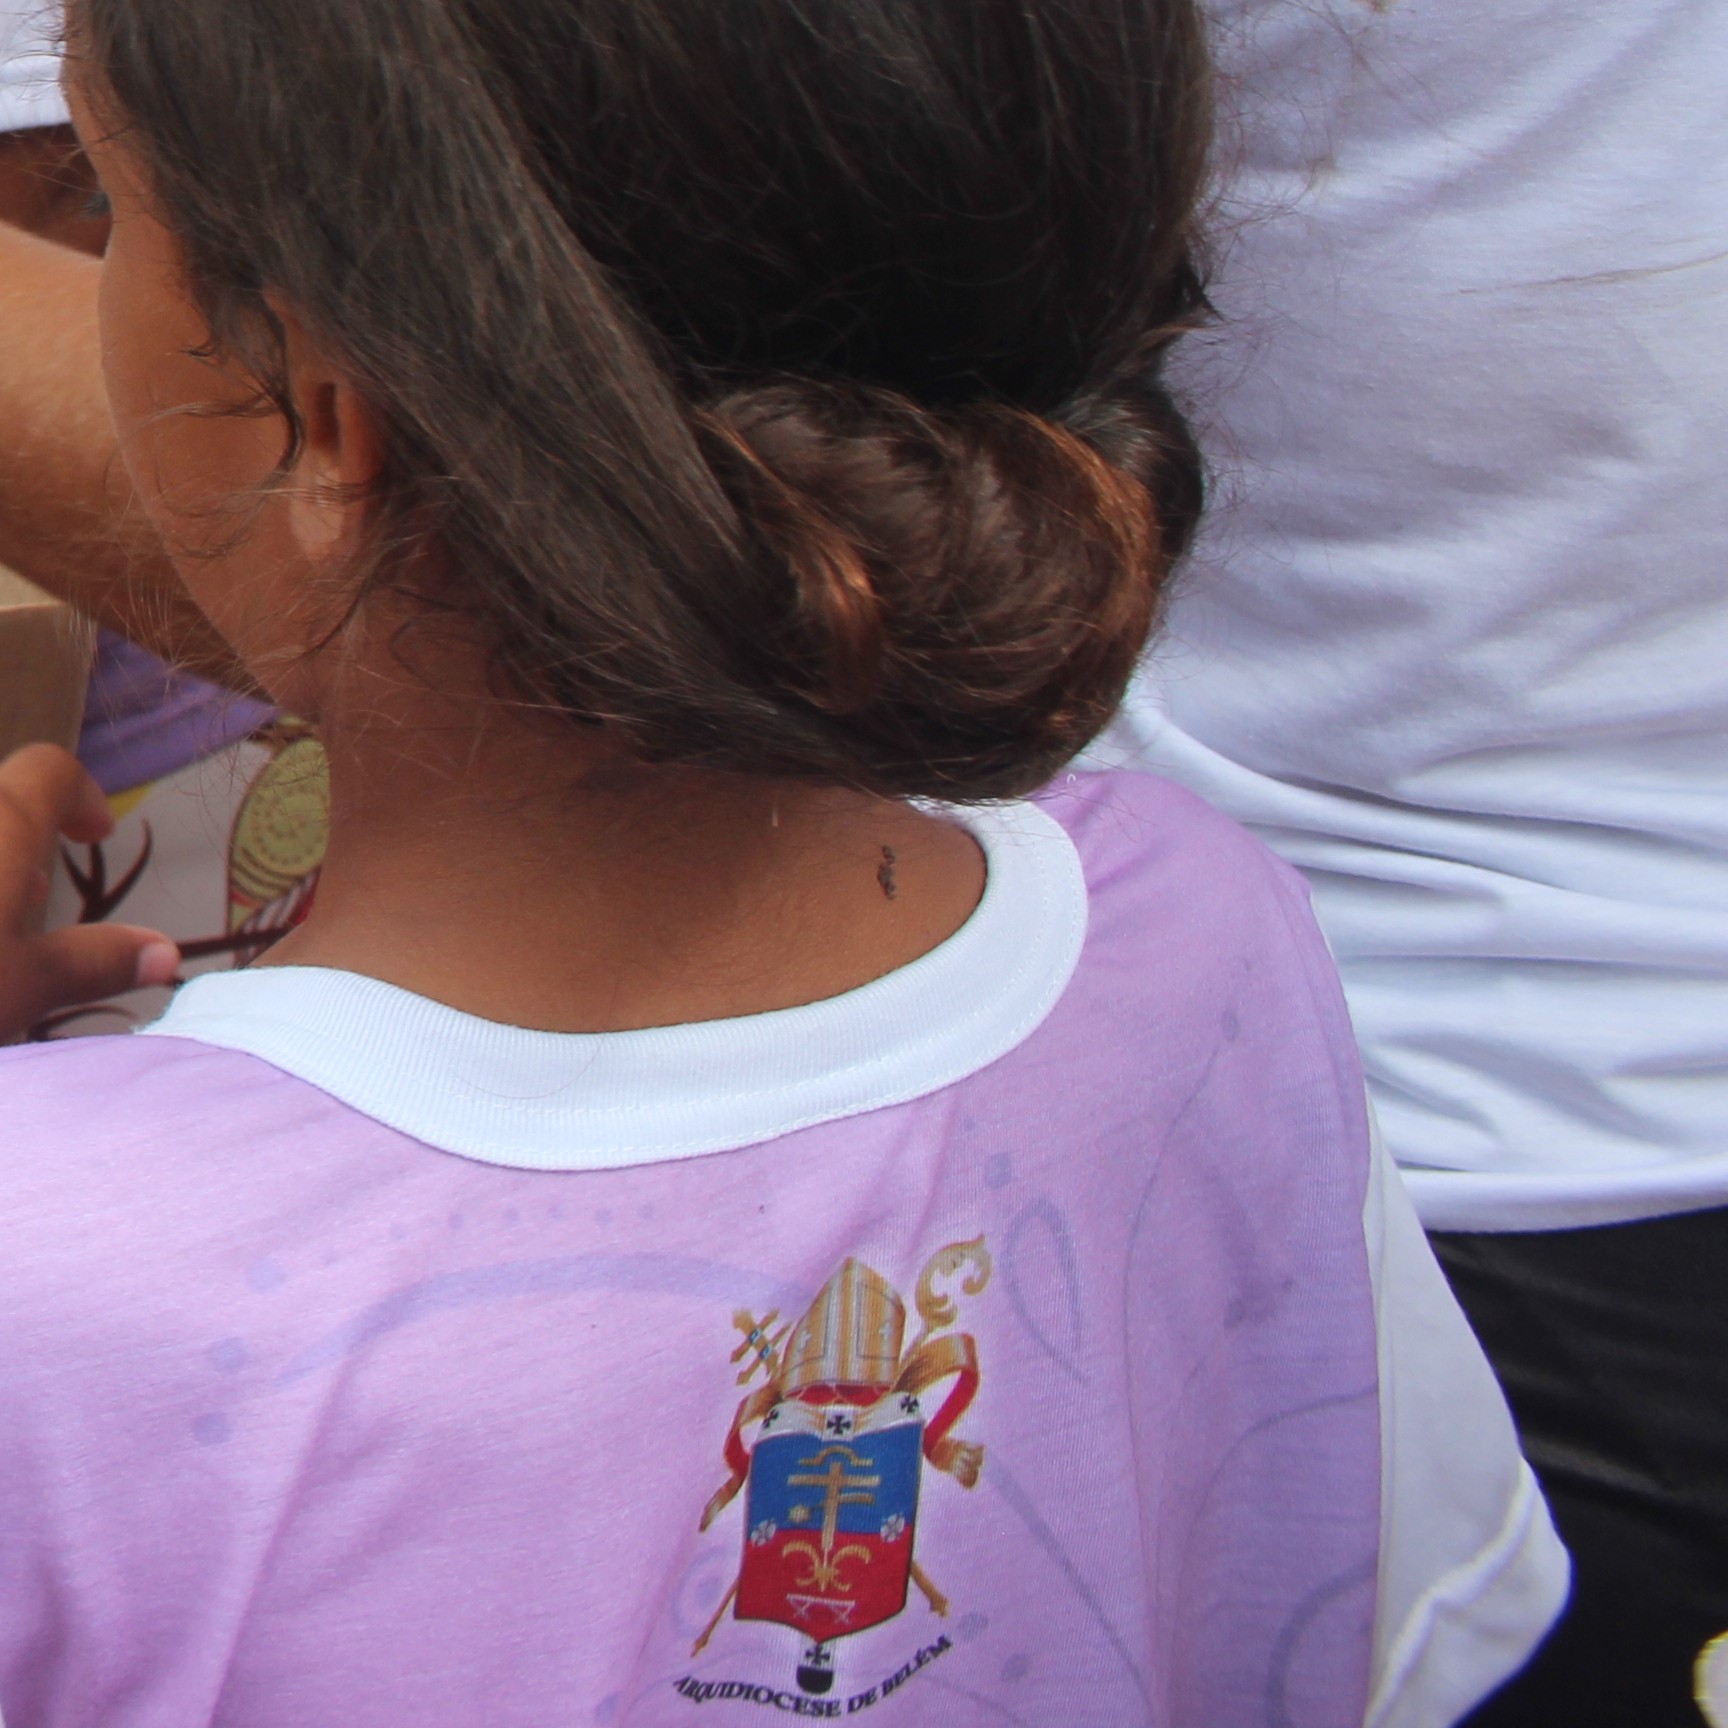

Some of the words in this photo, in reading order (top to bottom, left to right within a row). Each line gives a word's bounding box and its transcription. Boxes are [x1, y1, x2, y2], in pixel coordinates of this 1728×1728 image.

[672, 1674, 842, 1718] ARQUIDIOCESE
[847, 1687, 879, 1714] DE
[881, 1633, 953, 1697] BELÉM
